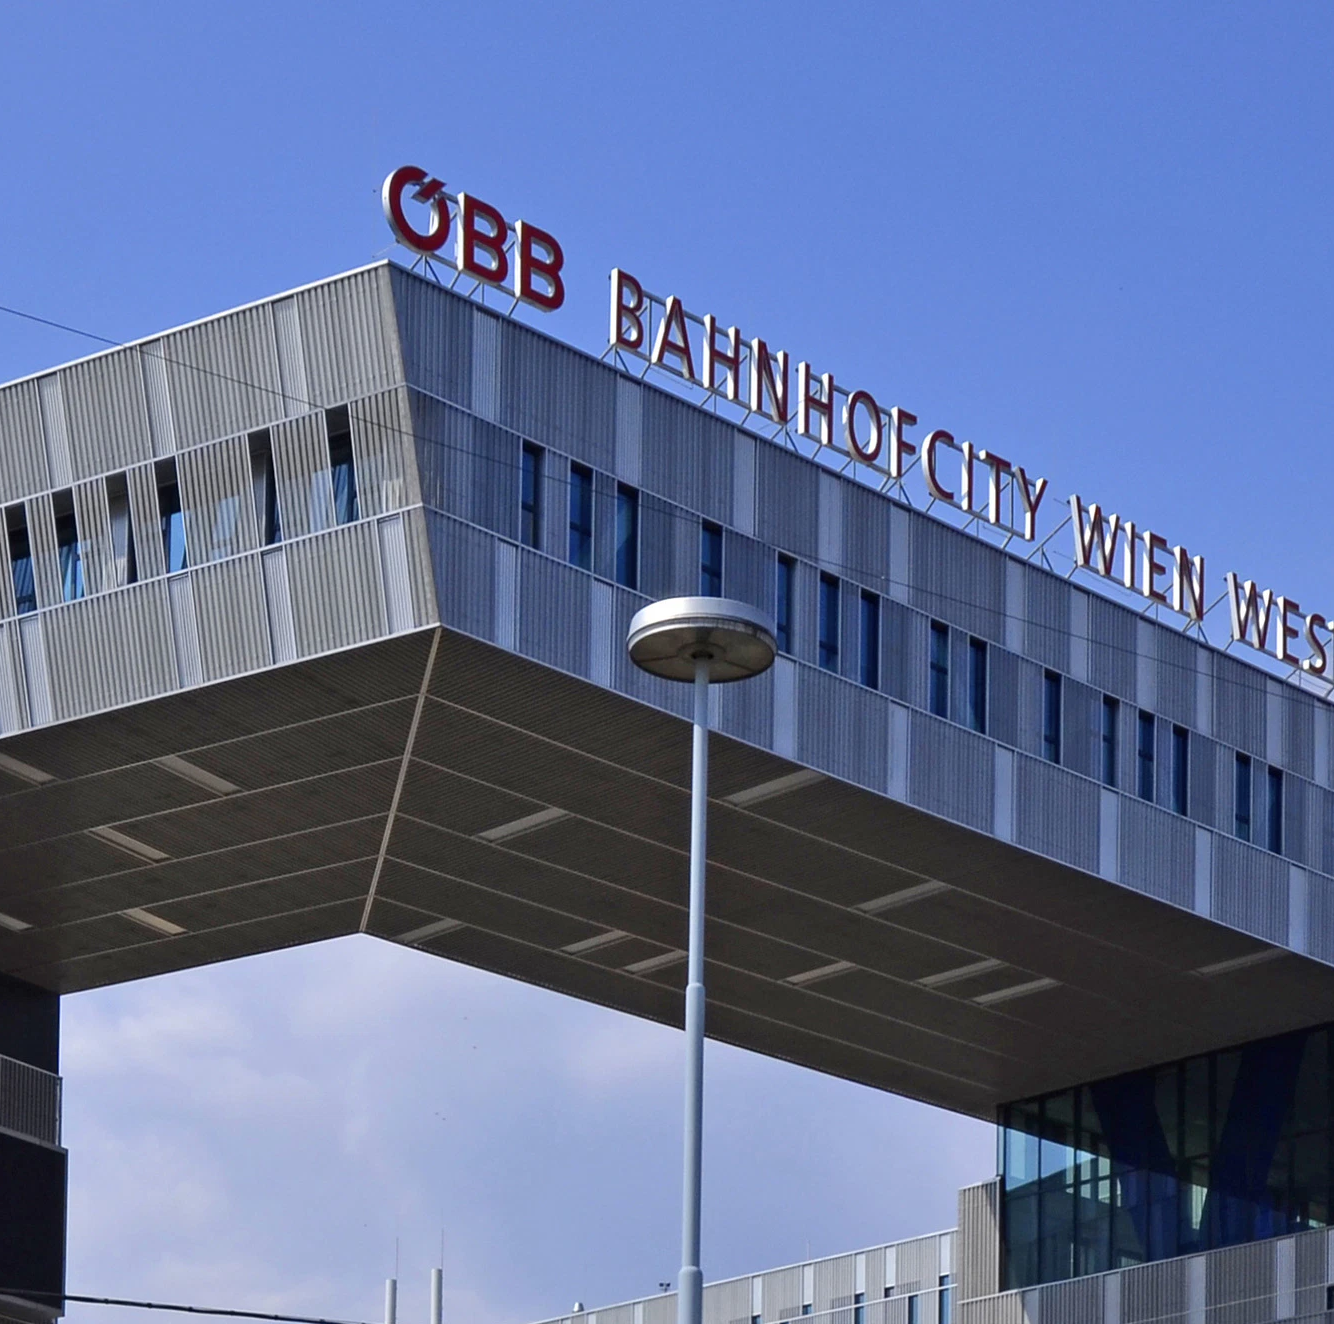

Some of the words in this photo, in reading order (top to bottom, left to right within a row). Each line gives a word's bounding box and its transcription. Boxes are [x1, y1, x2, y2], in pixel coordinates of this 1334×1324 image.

[382, 166, 565, 313] ÖBB
[610, 267, 1048, 541] BAHNHOFCITY
[1069, 494, 1204, 622] WIEN
